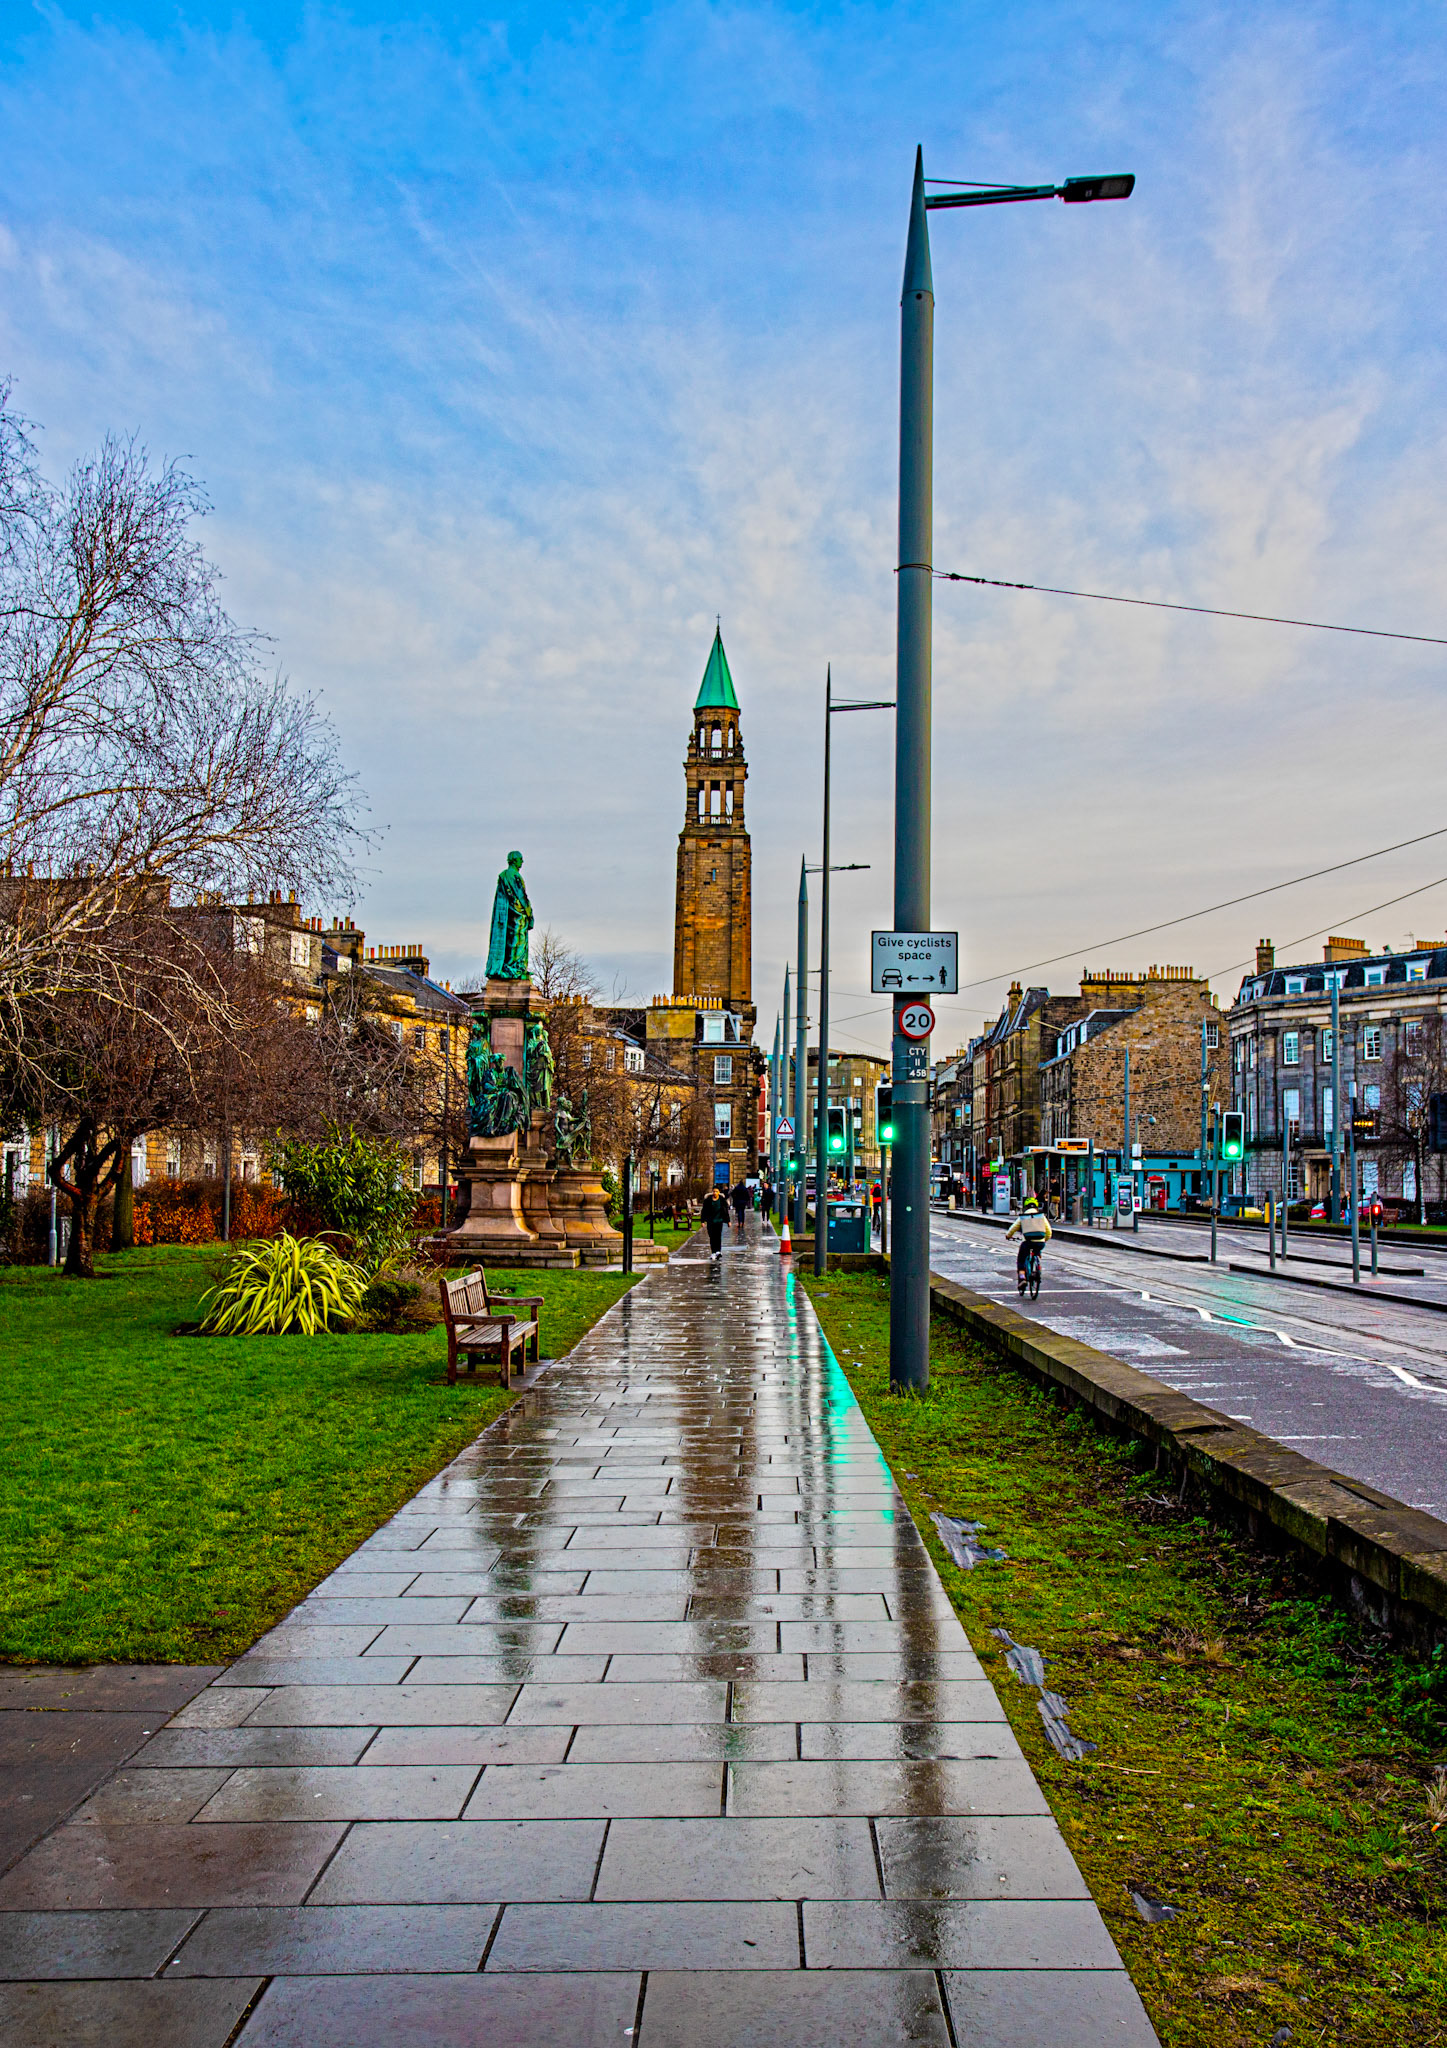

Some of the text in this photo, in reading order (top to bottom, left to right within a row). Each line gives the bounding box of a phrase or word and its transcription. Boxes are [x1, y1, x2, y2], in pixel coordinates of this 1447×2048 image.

[878, 937, 952, 949] Give cyclists
[898, 952, 932, 961] space
[905, 1013, 930, 1028] 20
[909, 1047, 926, 1056] CTY
[909, 1069, 927, 1077] 45B
